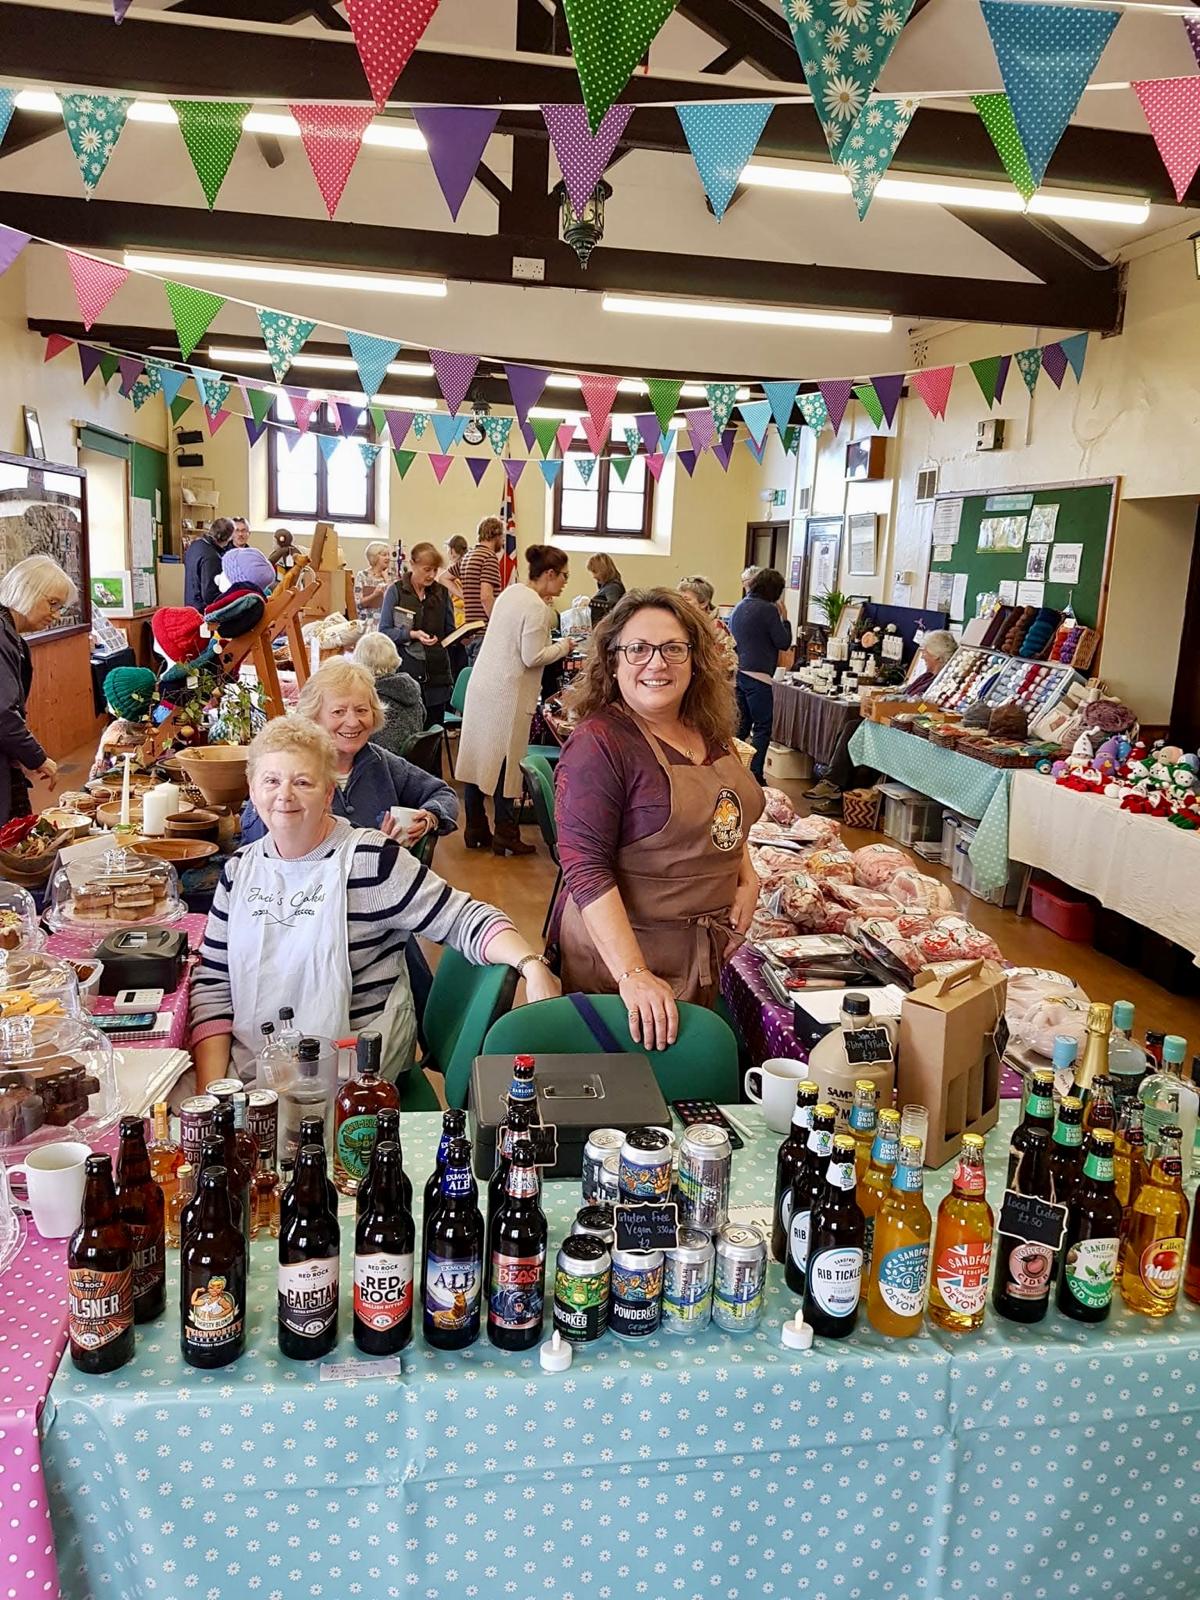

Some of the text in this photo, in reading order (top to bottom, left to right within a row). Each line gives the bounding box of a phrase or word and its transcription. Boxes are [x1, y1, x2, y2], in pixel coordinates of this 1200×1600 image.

[246, 1119, 276, 1136] OLLYS
[1006, 1196, 1062, 1221] Local Cider
[624, 1223, 652, 1238] Vegan
[793, 1227, 806, 1240] RIB
[312, 1268, 329, 1278] ROCK
[434, 1272, 476, 1290] ALE
[498, 1267, 542, 1284] BEAST
[817, 1265, 862, 1281] RIB TICKLE
[1017, 1272, 1049, 1286] CIDER
[366, 1275, 400, 1290] RED
[1070, 1280, 1086, 1299] OLD
[287, 1279, 337, 1309] CAPSTAN
[360, 1285, 406, 1303] ROCK
[885, 1287, 916, 1311] DEVON
[943, 1286, 977, 1309] DEVON
